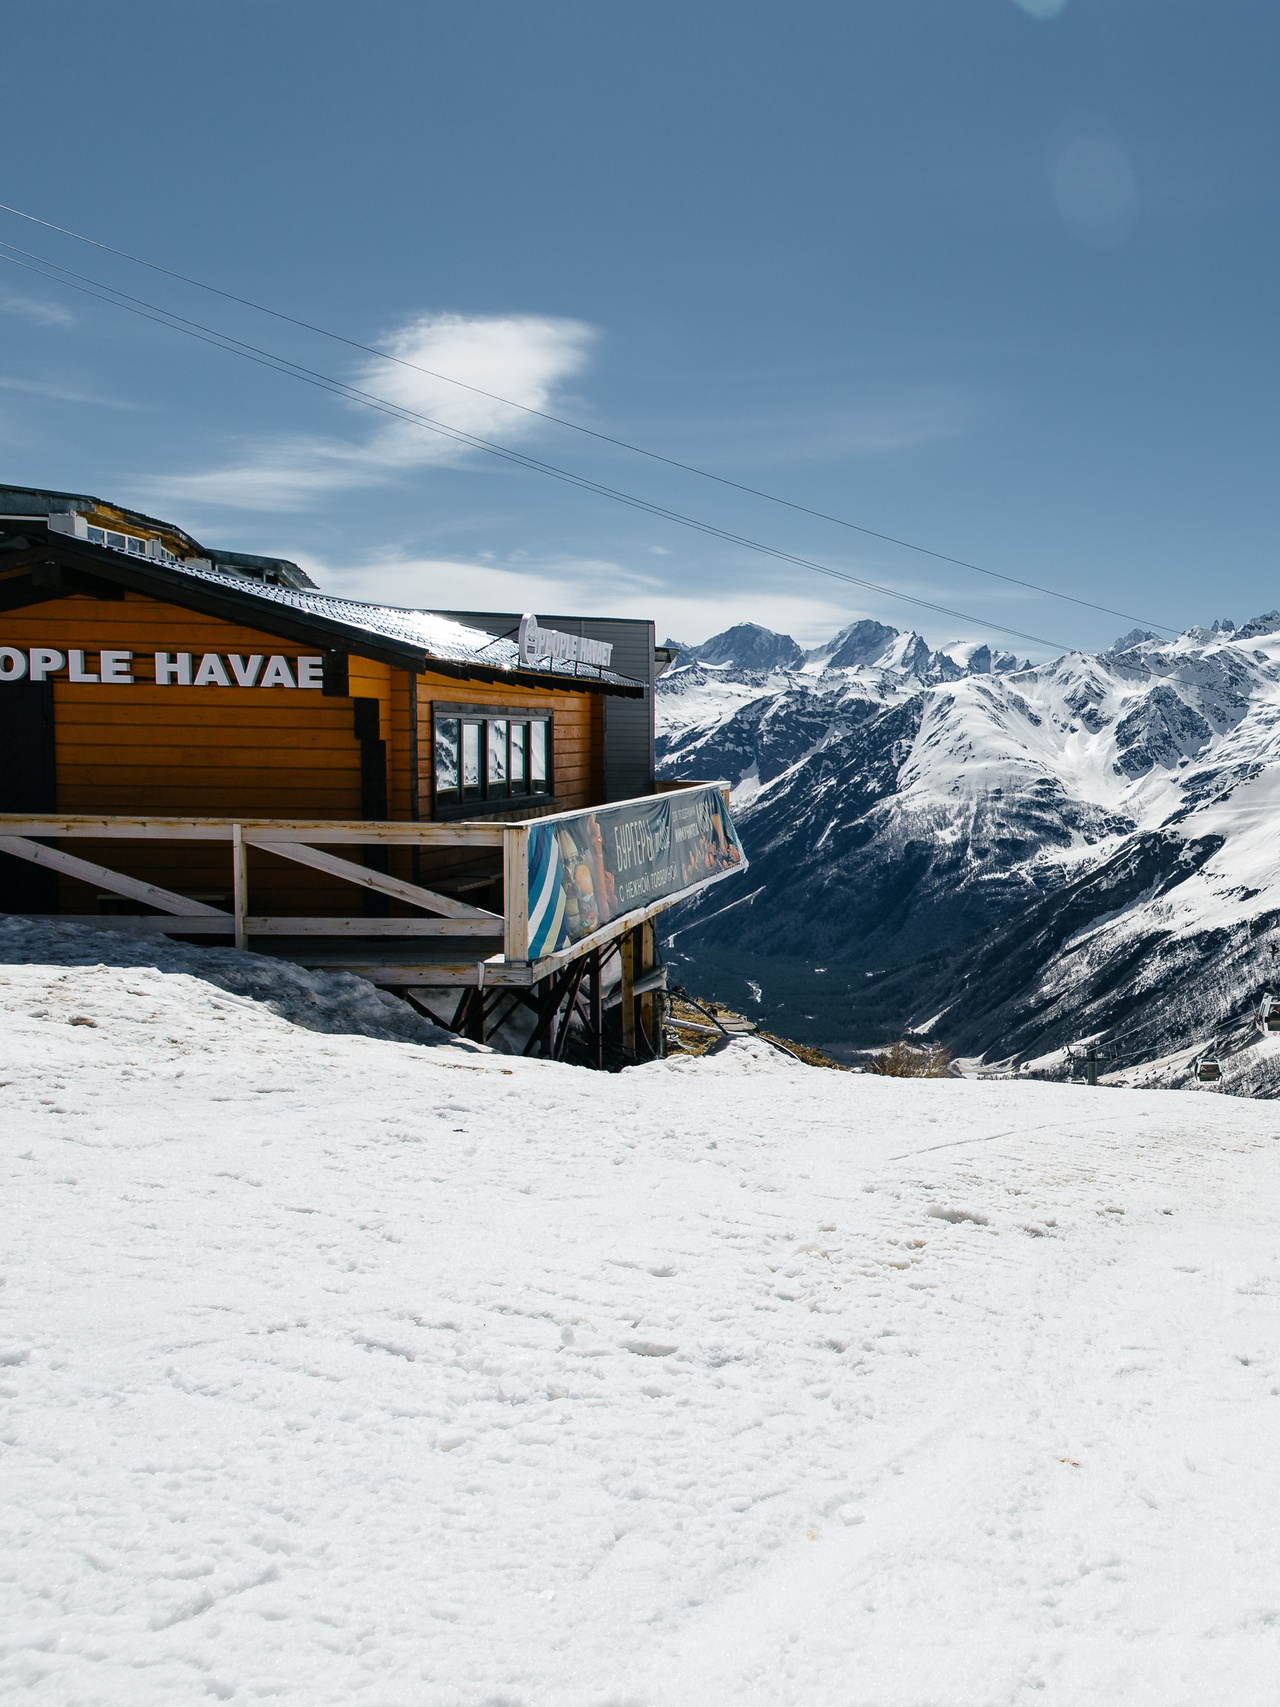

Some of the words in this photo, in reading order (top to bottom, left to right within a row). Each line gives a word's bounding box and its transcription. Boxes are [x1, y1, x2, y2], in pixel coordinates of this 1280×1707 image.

[154, 652, 323, 689] HAVAE
[614, 819, 655, 872] БУРГЕРЫ
[625, 872, 651, 900] НЕЖНОЙ
